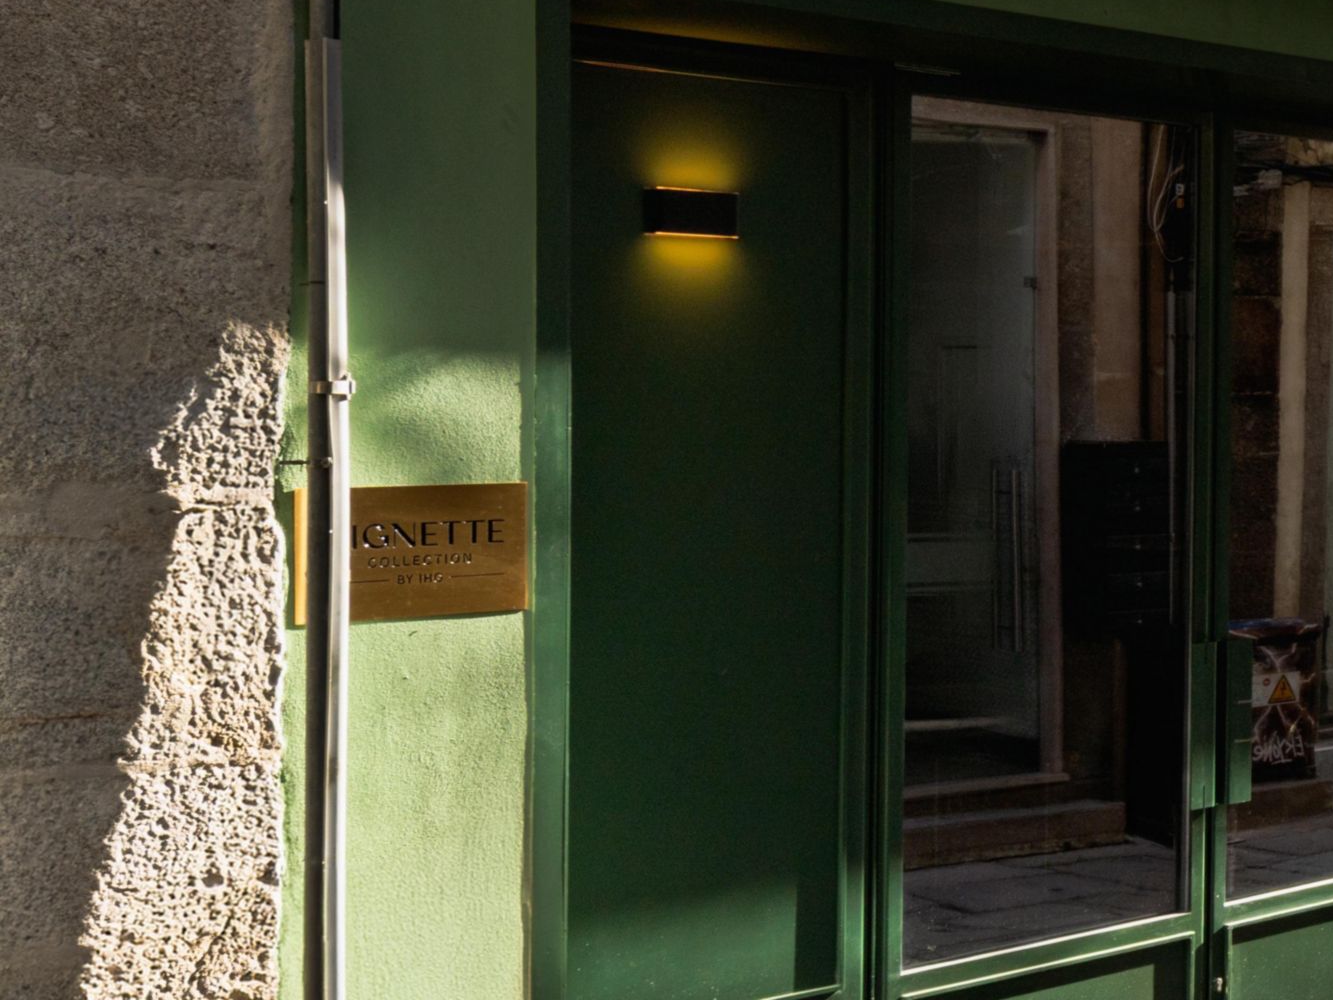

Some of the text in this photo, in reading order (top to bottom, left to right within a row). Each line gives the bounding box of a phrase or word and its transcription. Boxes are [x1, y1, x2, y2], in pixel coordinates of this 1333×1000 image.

[352, 518, 505, 550] IGNETTE
[367, 552, 473, 569] COLLECTION
[397, 572, 444, 585] BY IHG
